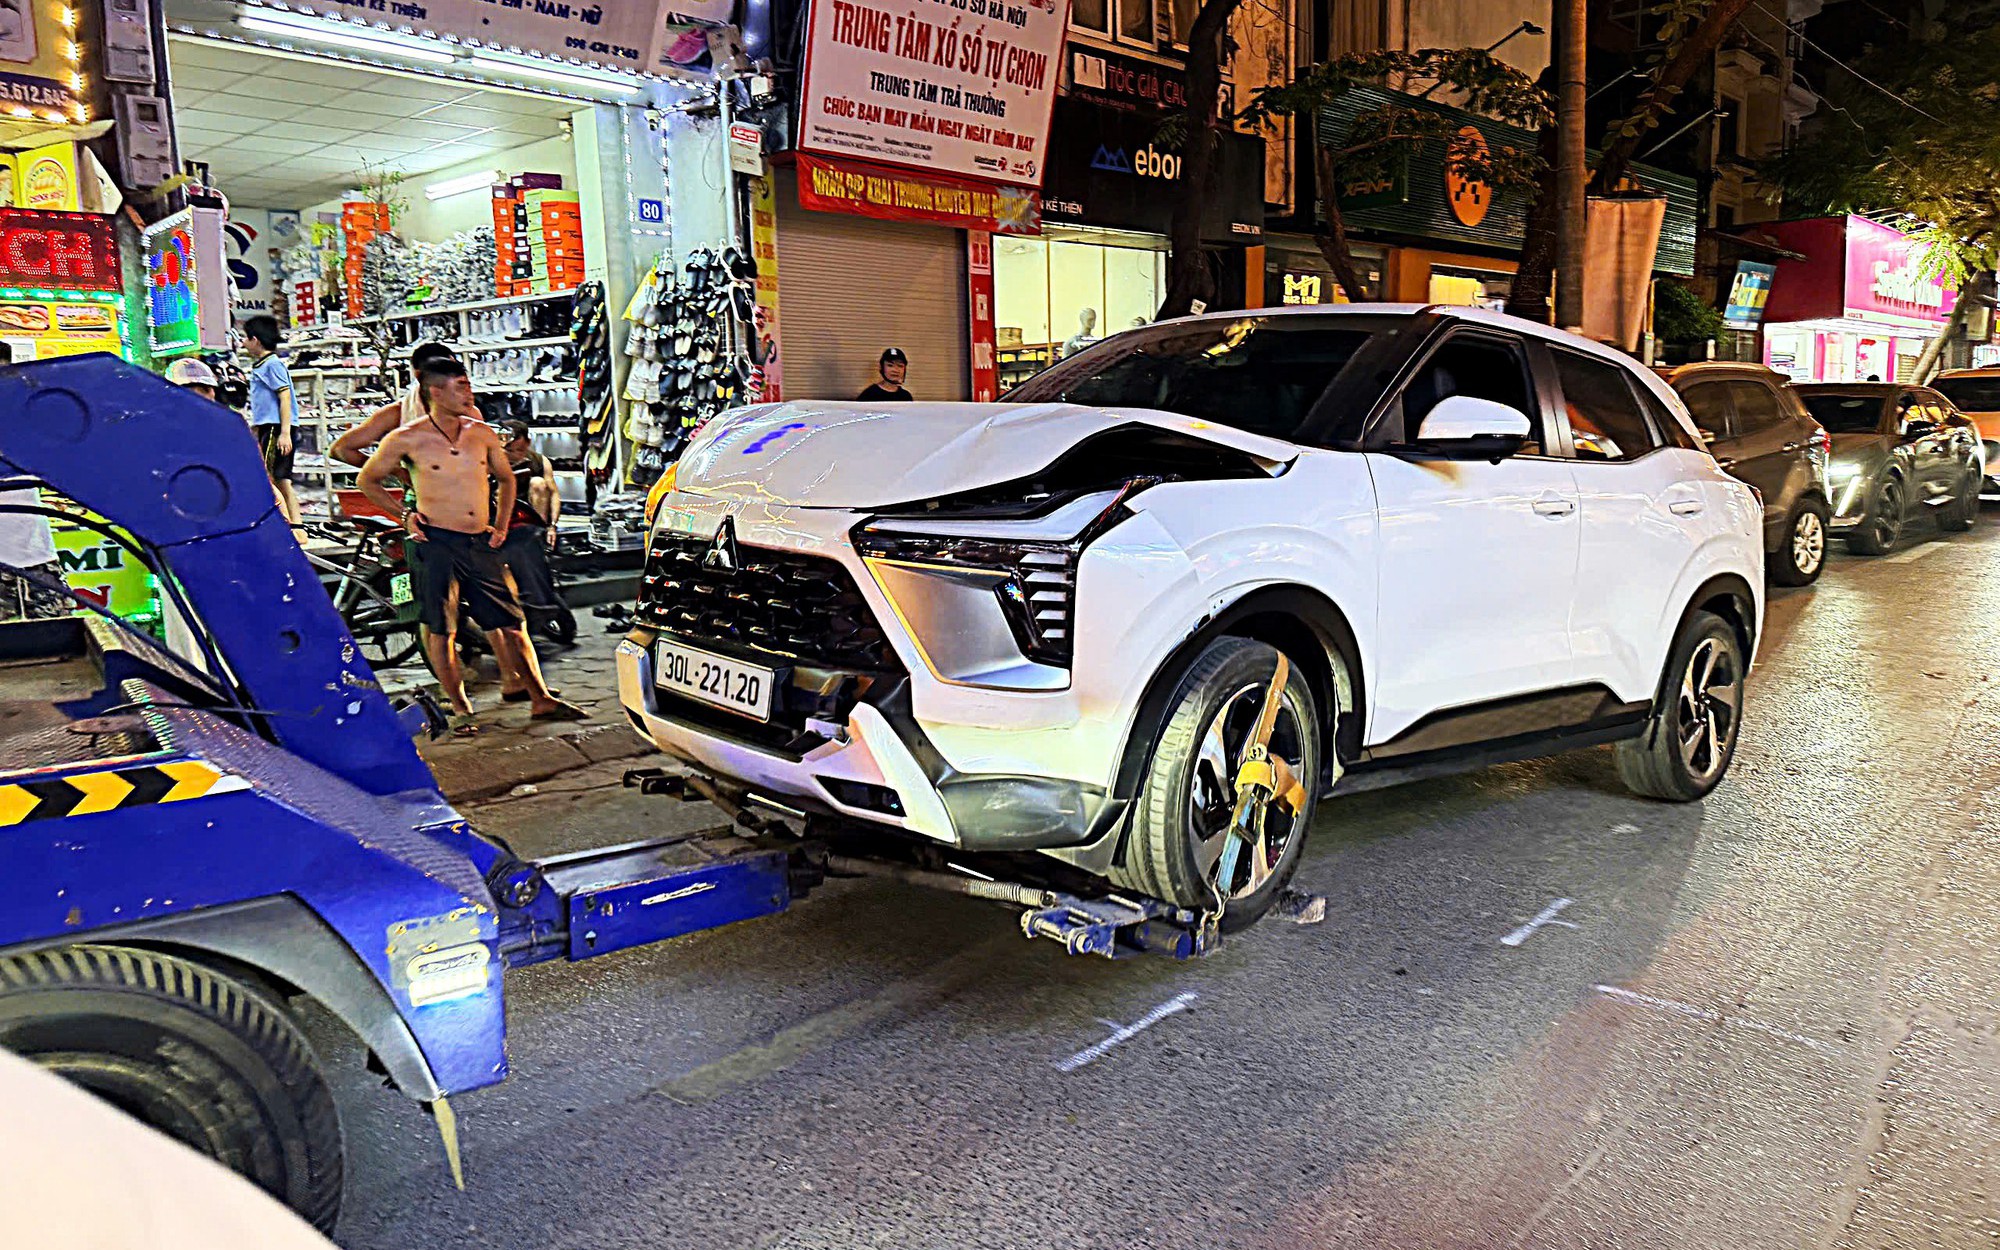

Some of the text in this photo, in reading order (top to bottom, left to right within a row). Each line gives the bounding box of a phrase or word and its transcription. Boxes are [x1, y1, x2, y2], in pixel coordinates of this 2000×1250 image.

[534, 0, 571, 19] NAM
[1006, 6, 1028, 30] NỘI
[832, 0, 1048, 97] TRUNG TÂM XỔ SỐ TỰ CHỌN
[870, 71, 1006, 118] TRUNG TÂM TRẢ THƯỞNG
[823, 92, 856, 119] CHÚC
[857, 102, 881, 126] BẠN
[884, 108, 909, 129] MAY
[937, 120, 963, 140] NGAY
[1016, 134, 1036, 153] NAY
[866, 174, 893, 206] KHAI
[642, 202, 660, 219] 80
[664, 652, 760, 707] 30L-221.20
